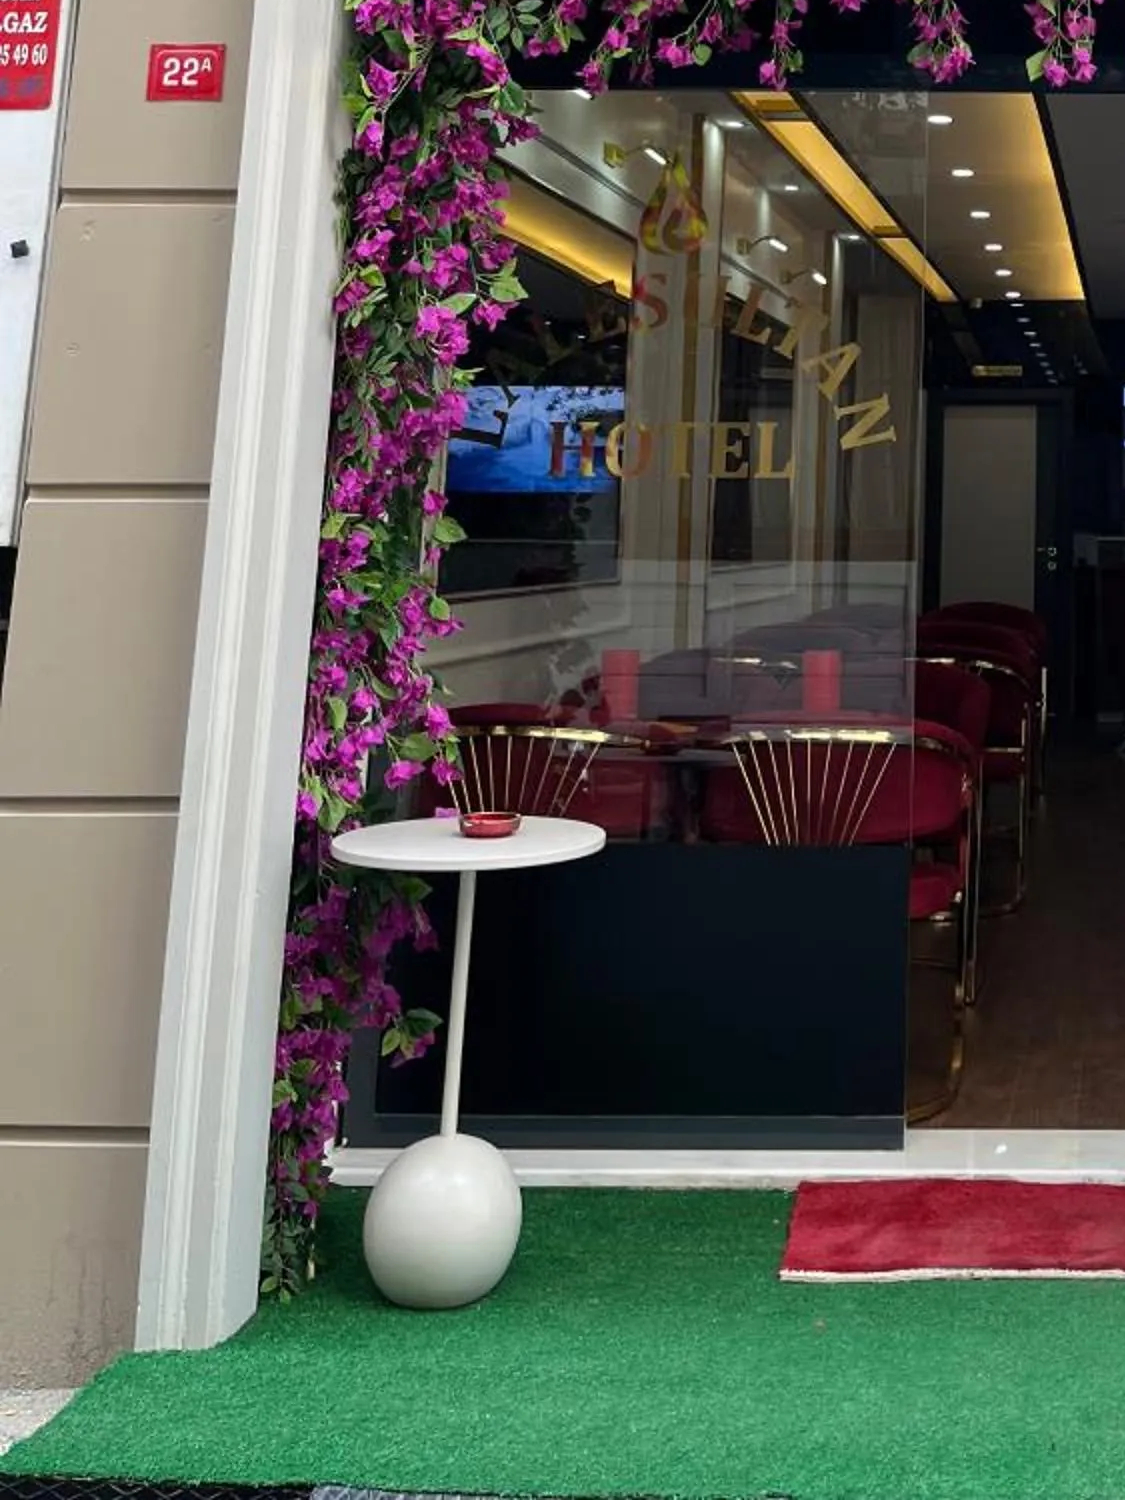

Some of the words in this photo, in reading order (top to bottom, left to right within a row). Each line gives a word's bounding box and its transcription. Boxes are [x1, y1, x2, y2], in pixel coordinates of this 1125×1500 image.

[13, 43, 29, 66] 49
[31, 43, 48, 66] 60
[549, 420, 796, 480] HOTEL
